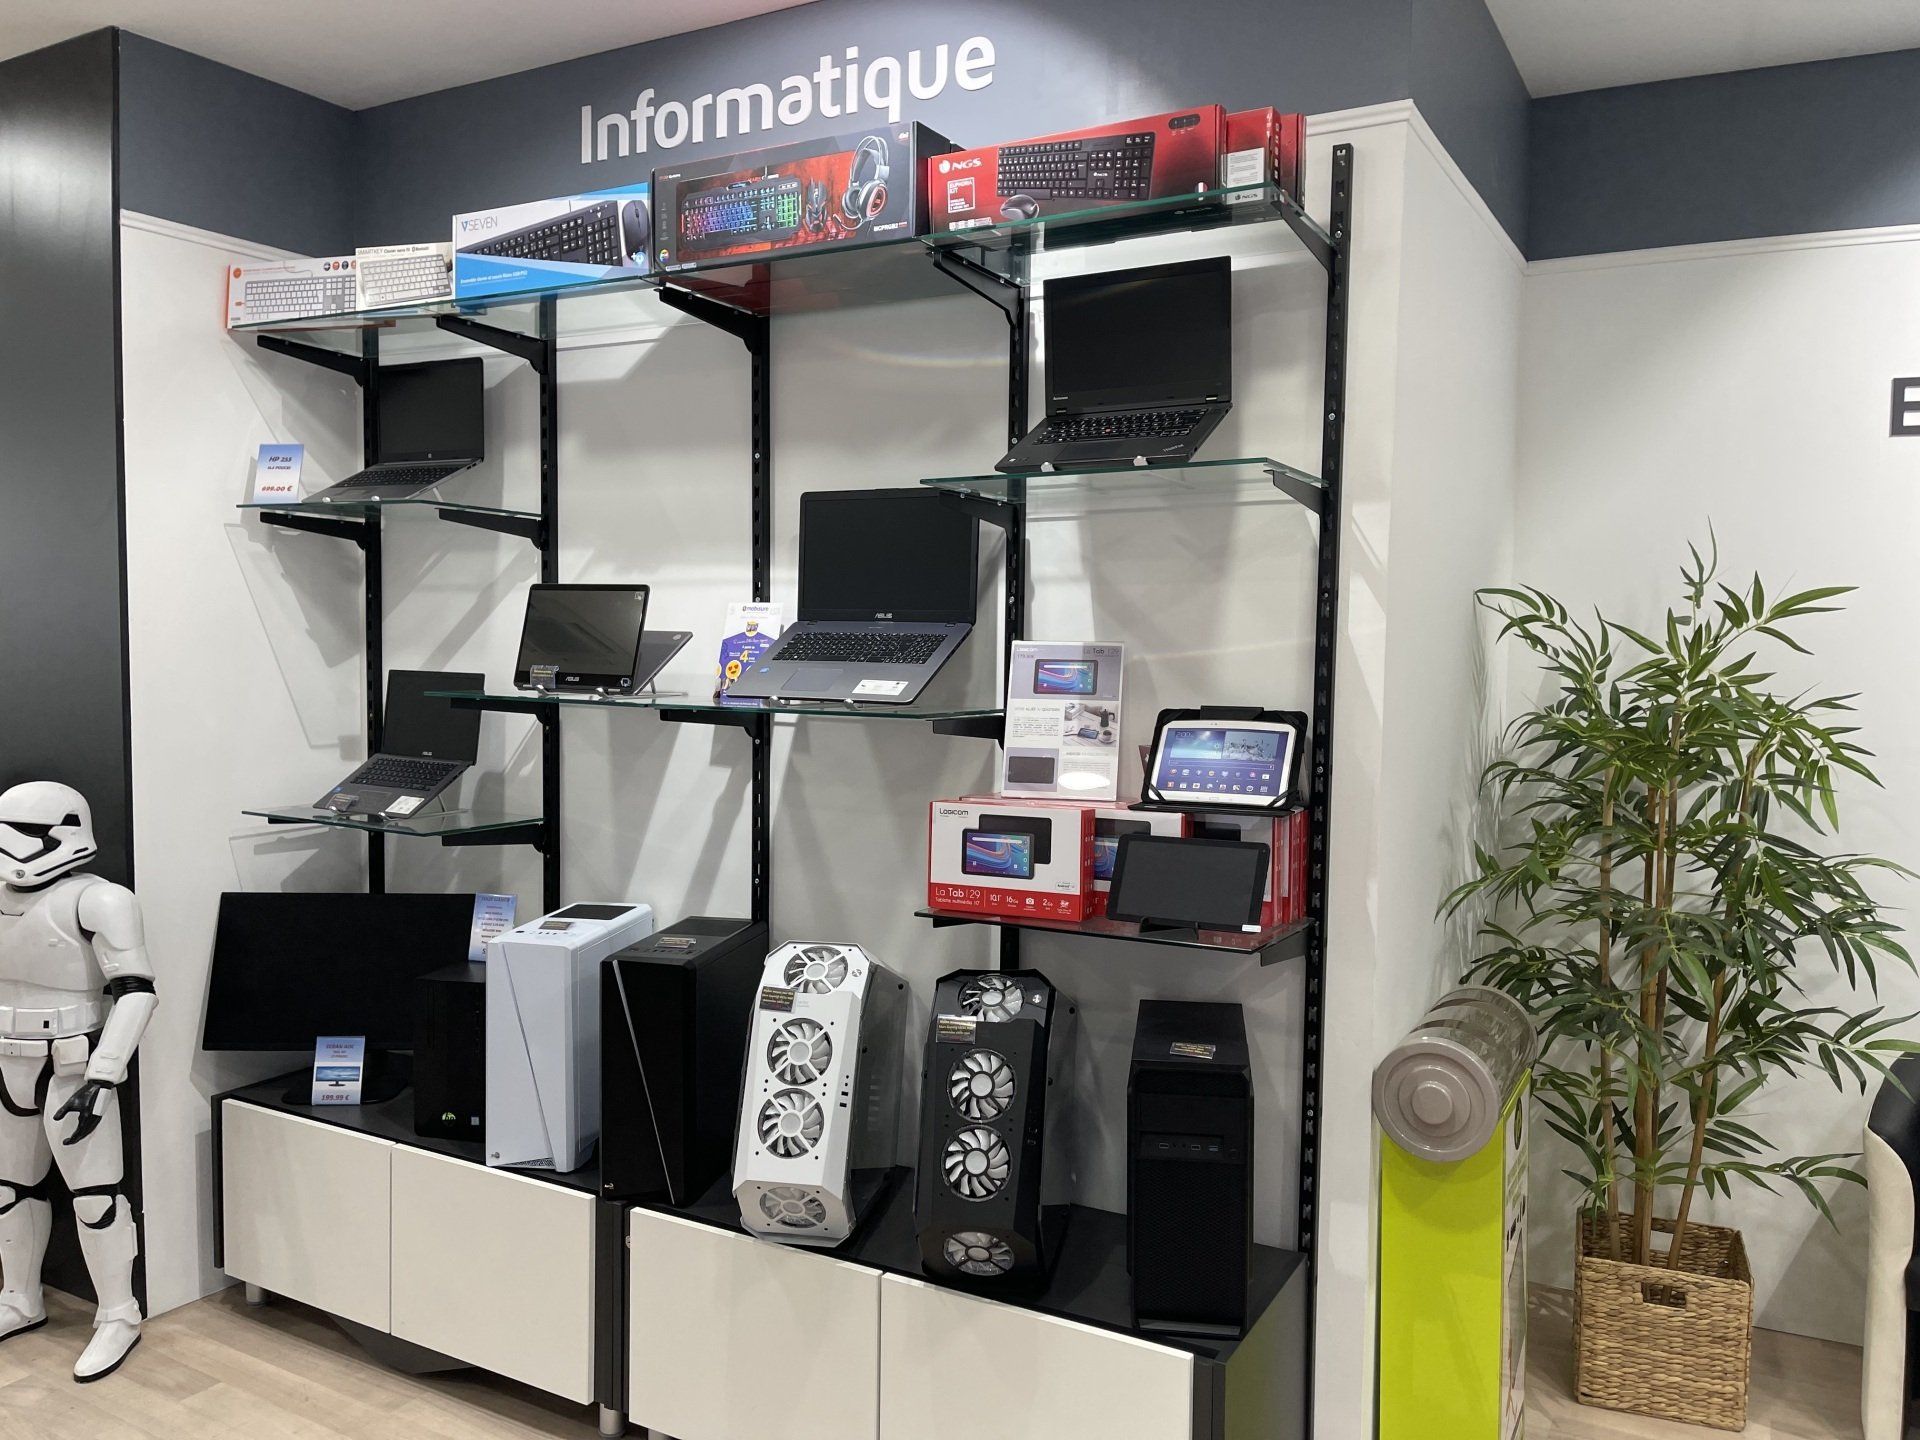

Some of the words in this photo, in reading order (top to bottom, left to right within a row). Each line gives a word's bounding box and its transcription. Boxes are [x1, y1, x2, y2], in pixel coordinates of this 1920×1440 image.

[581, 35, 996, 164] Informatique
[952, 158, 981, 171] NGS
[1092, 647, 1105, 655] Tab
[935, 886, 946, 896] La
[948, 887, 964, 898] Tab
[969, 889, 981, 899] 29
